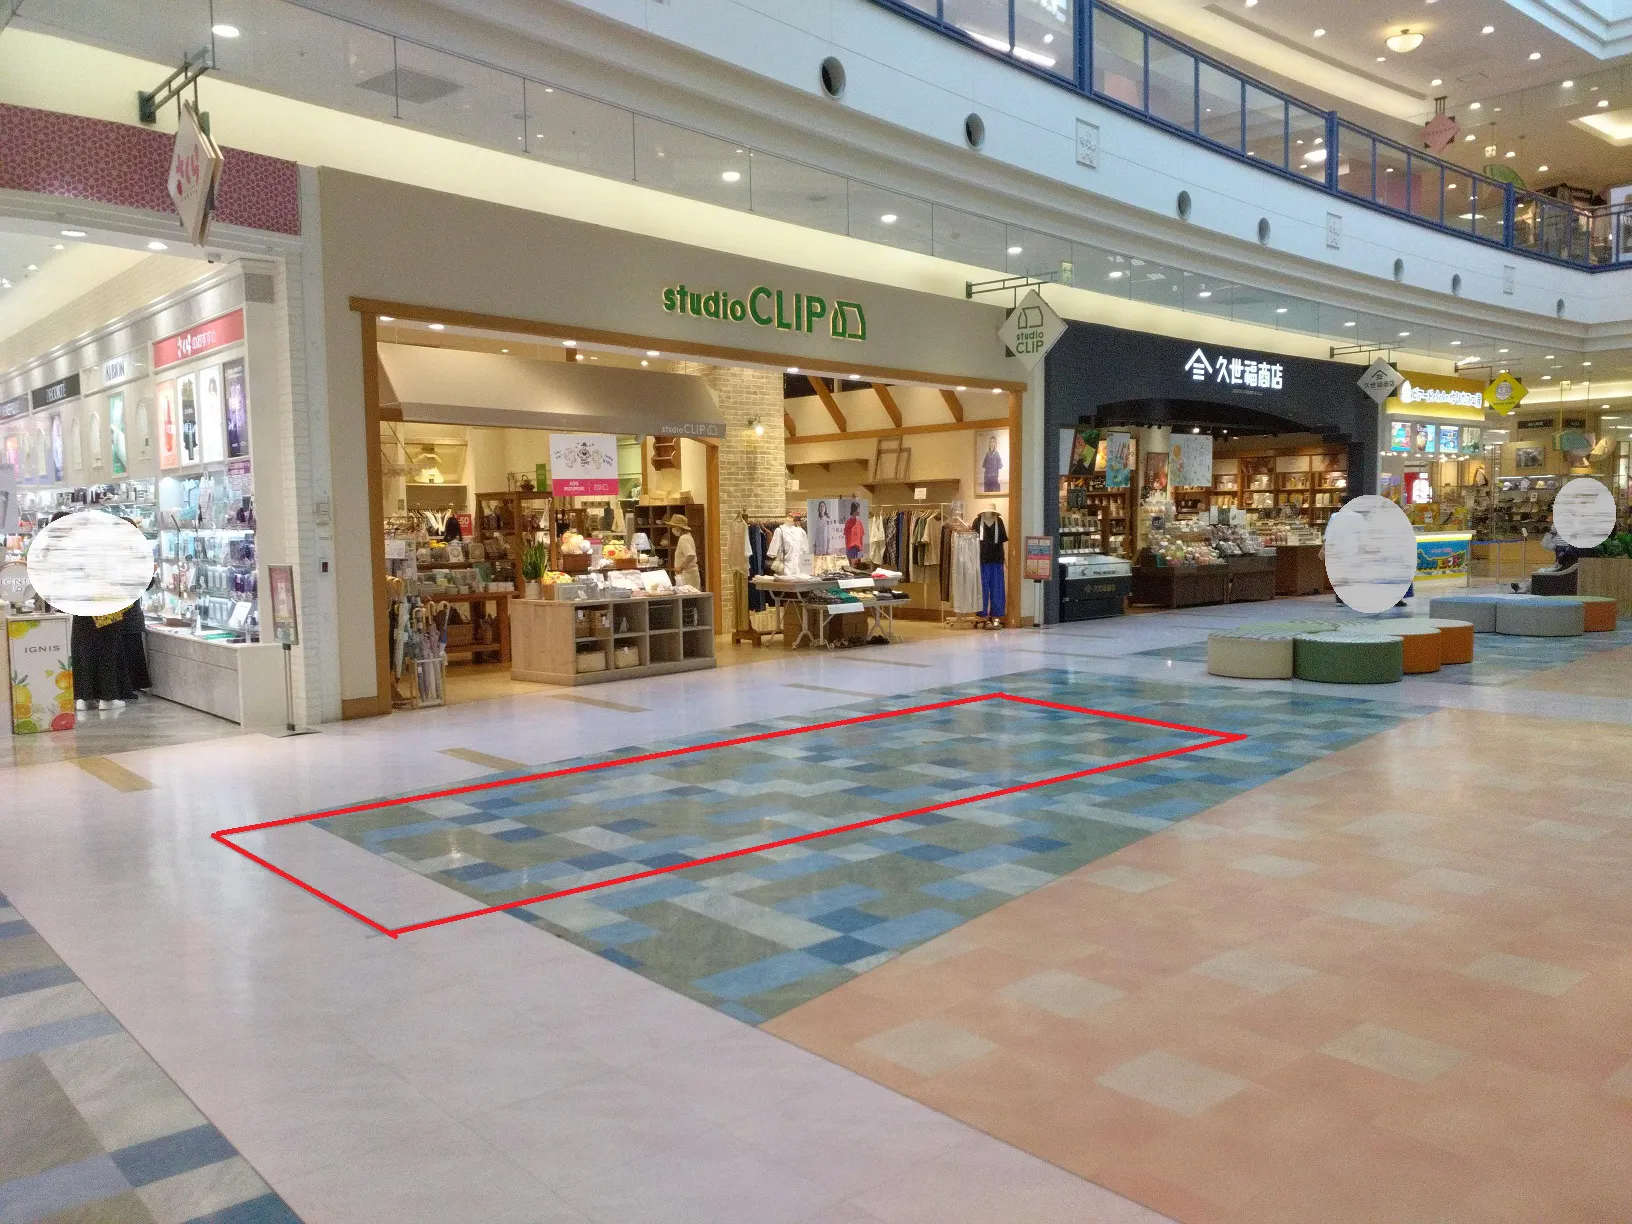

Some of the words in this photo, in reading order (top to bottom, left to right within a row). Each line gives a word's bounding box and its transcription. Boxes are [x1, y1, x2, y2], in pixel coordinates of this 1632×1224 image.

[662, 284, 747, 322] studio
[748, 285, 828, 334] CLIP
[1016, 330, 1045, 341] studio
[1015, 339, 1045, 354] CLIP
[1215, 355, 1284, 390] 久世福商店
[661, 425, 684, 435] studio
[683, 423, 706, 435] CLIP
[24, 645, 61, 654] IGNIS
